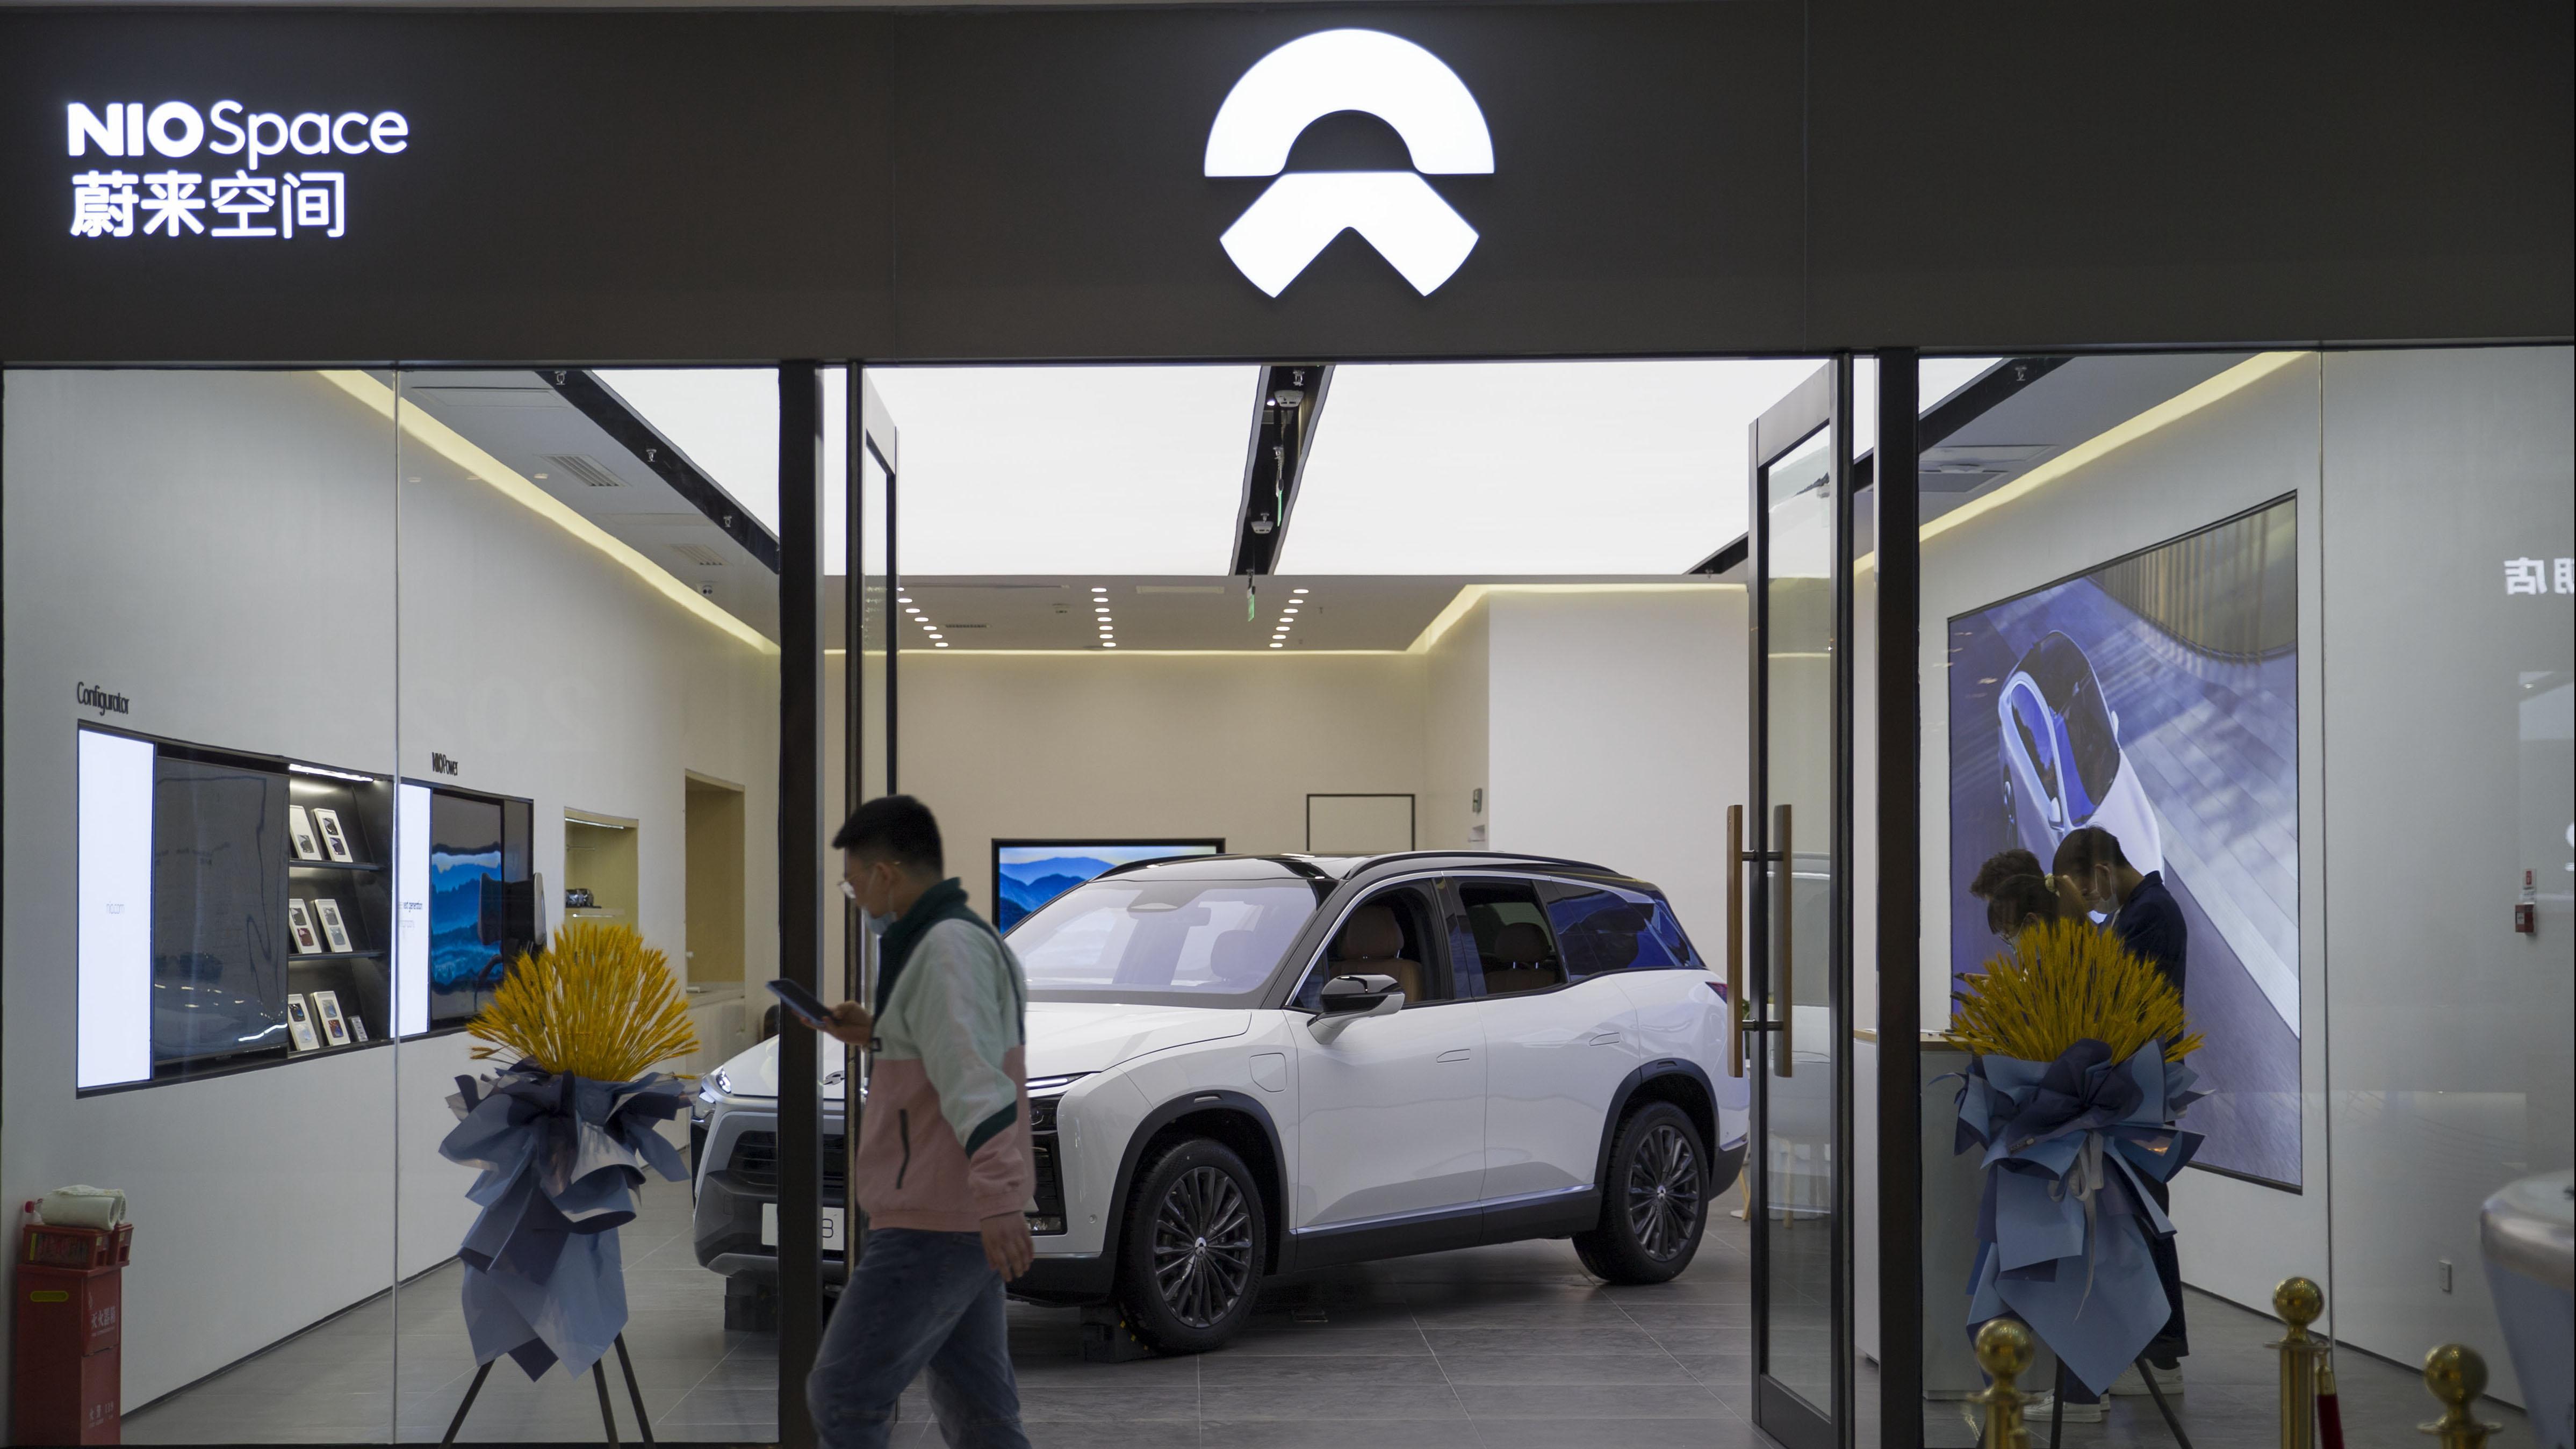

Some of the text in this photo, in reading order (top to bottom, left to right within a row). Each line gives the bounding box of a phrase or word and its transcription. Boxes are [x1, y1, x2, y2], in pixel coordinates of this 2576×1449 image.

[67, 100, 408, 170] NIO Space
[70, 170, 344, 239] 蔚来空间
[77, 682, 129, 716] Configurator
